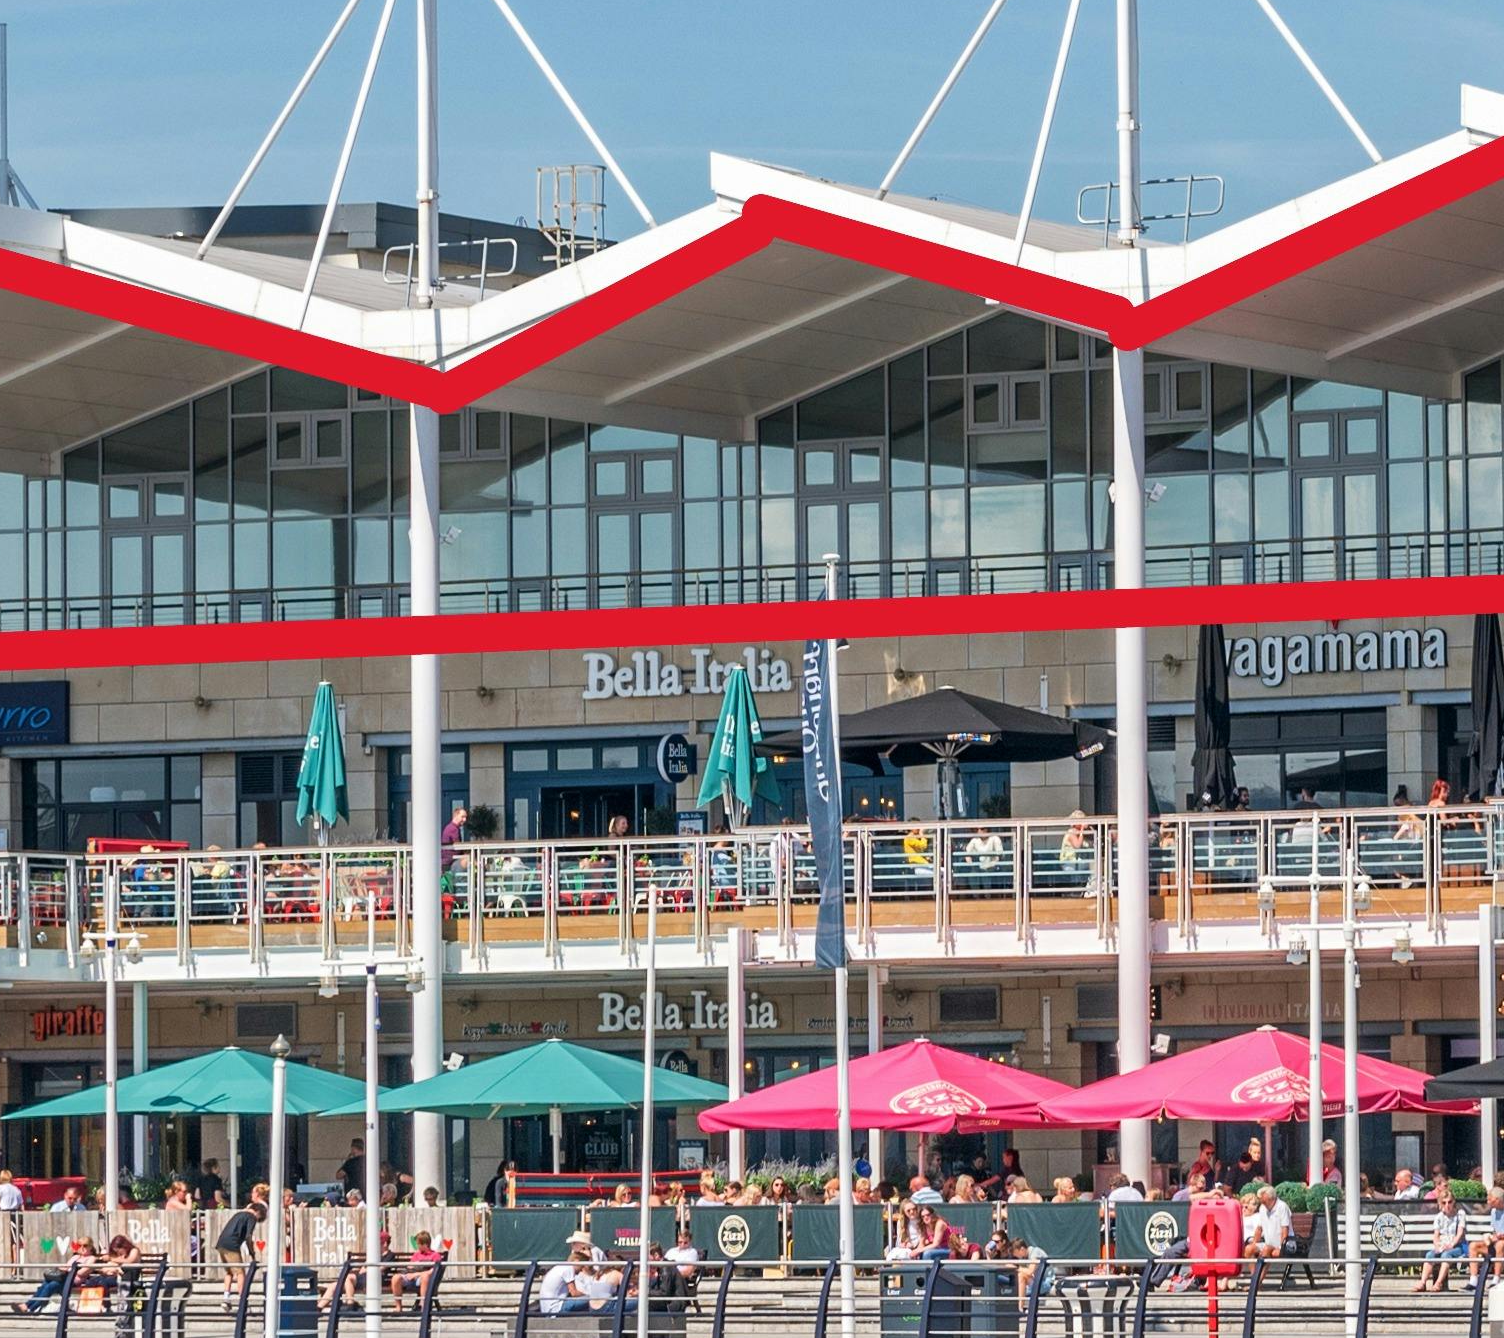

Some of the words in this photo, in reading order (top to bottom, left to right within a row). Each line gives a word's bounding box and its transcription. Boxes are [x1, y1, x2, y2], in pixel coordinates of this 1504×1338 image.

[1224, 626, 1446, 686] agamama
[582, 650, 683, 700] Bella
[668, 743, 688, 758] Bella
[668, 763, 689, 774] Italia
[31, 1005, 105, 1042] giraffe
[585, 1142, 619, 1156] CLUB
[128, 1219, 171, 1244] Bella
[314, 1217, 357, 1243] Bella
